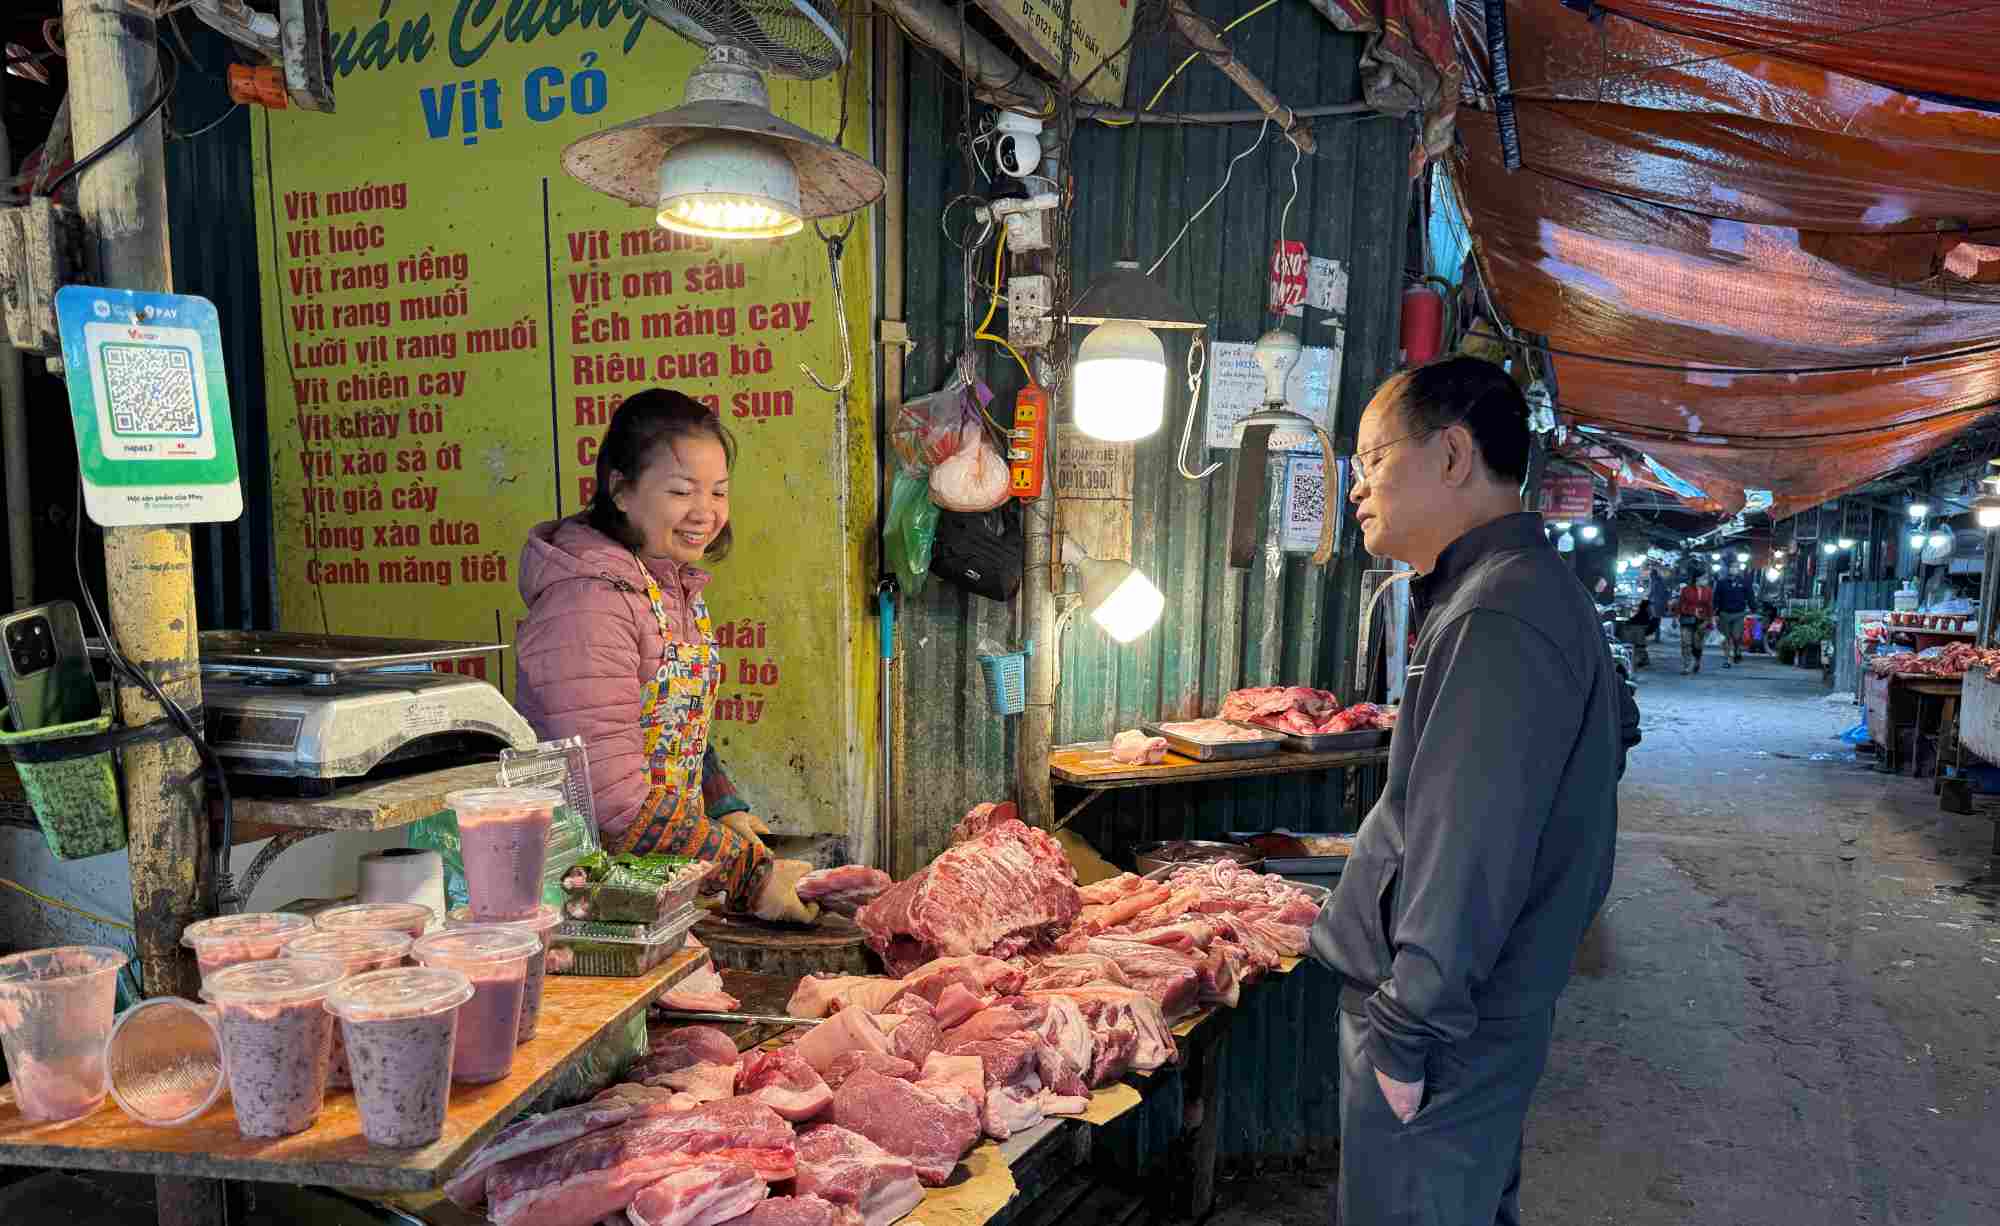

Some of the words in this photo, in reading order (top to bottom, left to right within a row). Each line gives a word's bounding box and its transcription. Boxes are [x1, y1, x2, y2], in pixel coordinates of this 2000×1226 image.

[329, 0, 434, 78] uán
[420, 78, 503, 146] Vịt
[523, 51, 609, 122] Cỏ
[284, 189, 319, 226] Vịt
[325, 180, 408, 216] nướng
[286, 228, 321, 263] Vịt
[328, 221, 385, 256] luộc
[569, 229, 611, 269] Vịt
[289, 265, 323, 300] Vịt
[330, 262, 389, 290] rang
[397, 245, 469, 283] riềng
[569, 270, 612, 308] Vịt
[622, 269, 673, 298] om
[684, 250, 746, 292] sấu
[290, 303, 325, 337] Vịt
[332, 301, 391, 328] rang
[399, 283, 468, 321] muối
[571, 303, 631, 345] Ếch
[641, 303, 736, 338] măng
[748, 299, 812, 332] cay
[293, 338, 348, 369] Lưỡi
[355, 335, 389, 369] vịt
[396, 332, 457, 360] rang
[466, 314, 538, 354] muối
[572, 352, 646, 385] Riêu
[656, 350, 720, 380] cua
[729, 341, 774, 377] bò
[295, 378, 330, 411] Vịt
[336, 371, 409, 401] chiên
[417, 370, 467, 400] cay
[575, 394, 625, 426] Riê
[731, 388, 795, 424] sụn
[297, 413, 333, 447] Vịt
[407, 403, 445, 434] tỏi
[301, 450, 334, 482] Vịt
[340, 447, 388, 476] xào
[395, 440, 428, 473] sả
[436, 440, 463, 472] ớt
[302, 486, 337, 519] Vịt
[343, 481, 384, 513] giả
[391, 476, 439, 512] cầy
[303, 517, 365, 552] Lòng
[373, 520, 421, 547] xào
[429, 517, 481, 546] dưa
[305, 558, 370, 585] Canh
[378, 554, 453, 586] măng
[460, 550, 508, 583] tiết
[738, 656, 780, 685] bò
